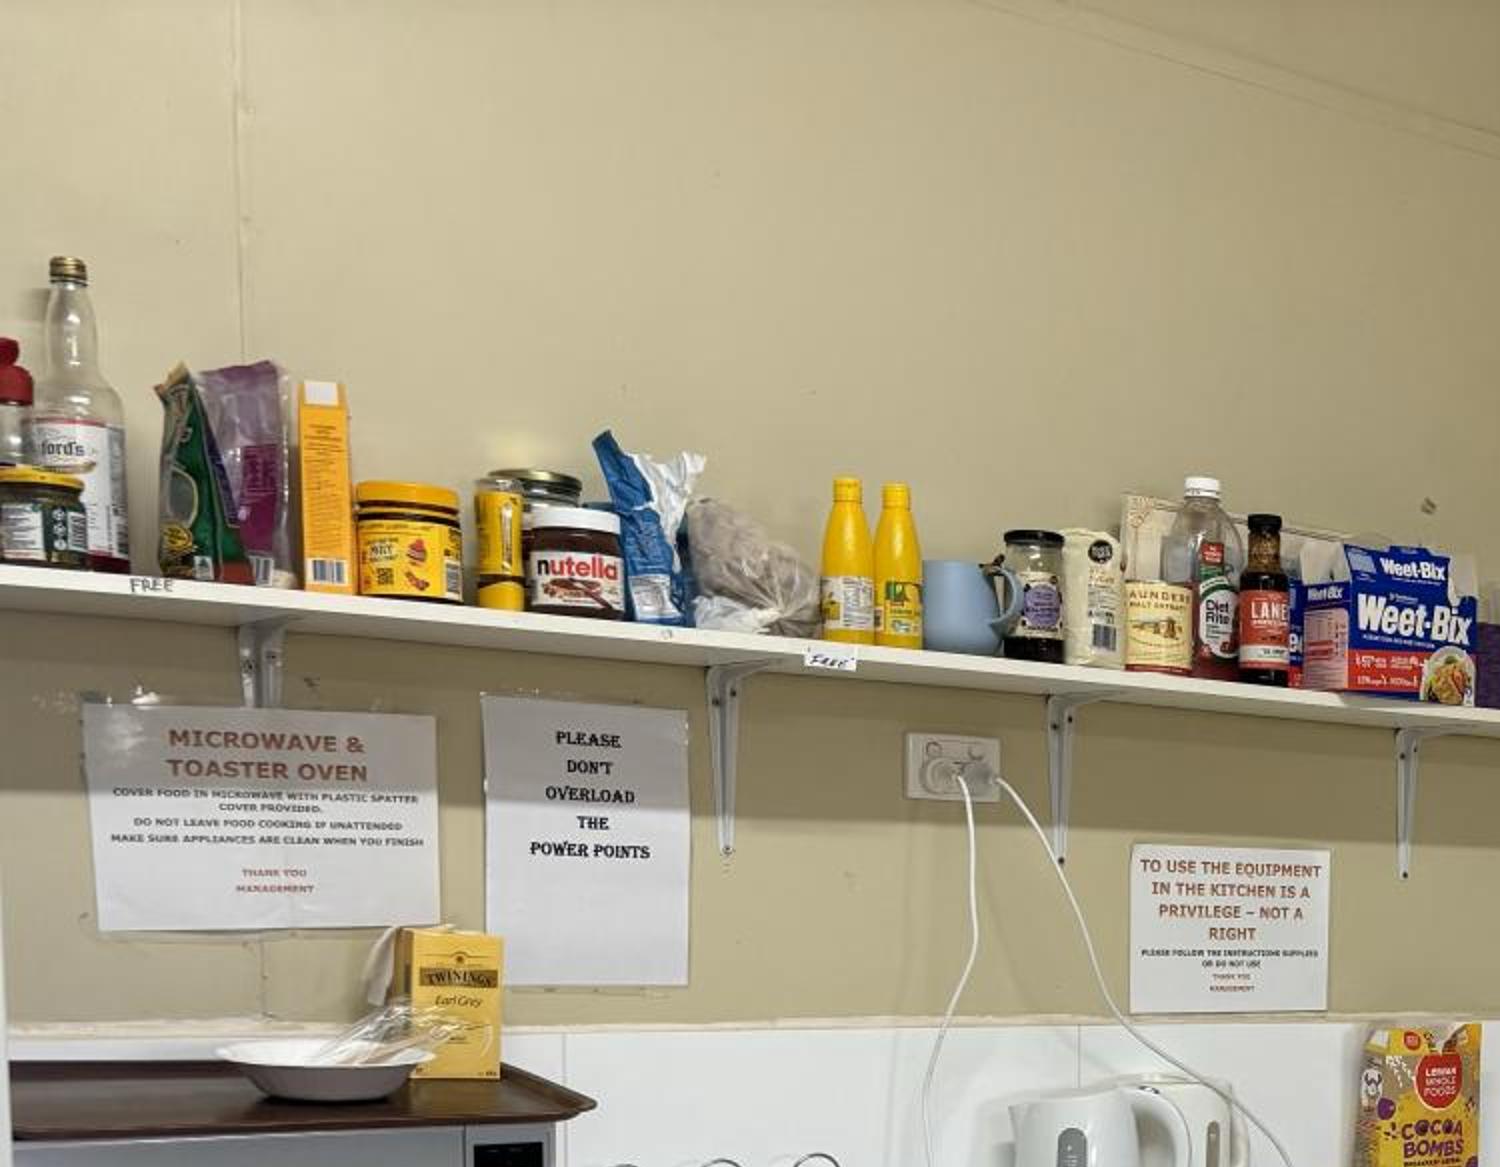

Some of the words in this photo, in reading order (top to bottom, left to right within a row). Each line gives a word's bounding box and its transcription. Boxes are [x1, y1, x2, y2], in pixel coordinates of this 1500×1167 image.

[537, 554, 619, 579] nutella
[1380, 557, 1446, 581] Weet-Bix
[130, 577, 173, 593] FREE
[1206, 599, 1229, 613] Diet
[1206, 612, 1230, 625] Rite
[1357, 593, 1472, 646] Weet-Bix
[169, 729, 337, 753] MICROWAVE
[346, 736, 365, 754] &
[556, 731, 622, 749] PLEASE
[166, 759, 288, 780] TOASTER
[297, 764, 367, 782] OVEN
[566, 759, 614, 775] DON'T
[113, 787, 153, 797] COVER
[157, 788, 191, 798] FOOD
[194, 789, 209, 798] IN
[212, 789, 283, 800] MICROWAVE
[287, 791, 318, 801] WITH
[321, 793, 367, 802] PLASTIC
[545, 786, 636, 804] OVERLOAD
[219, 803, 257, 812] COVER
[260, 804, 322, 813] PROVIDED.
[134, 818, 152, 827] DO
[156, 818, 179, 827] NOT
[183, 818, 220, 828] LEAVE
[224, 819, 254, 828] FOOD
[258, 819, 311, 829] COOKING
[315, 820, 327, 829] IF
[329, 821, 403, 831] UNATTENDED
[576, 815, 610, 831] THE
[111, 834, 144, 843] MAKE
[147, 834, 178, 843] SURE
[183, 835, 256, 844] APPLIANCES
[259, 836, 280, 845] ARE
[283, 836, 320, 845] CLEAN
[323, 837, 357, 846] WHEN
[360, 837, 382, 846] YOU
[385, 838, 424, 847] FINISH
[530, 841, 589, 858] POWER
[593, 844, 651, 860] POINTS
[242, 868, 280, 877] THANK
[283, 868, 307, 877] YOU
[1140, 858, 1162, 873] TO
[1167, 859, 1197, 874] USE
[1201, 861, 1231, 875] THE
[1235, 863, 1322, 878] EQUIPMENT
[236, 885, 314, 893] MANAGEMENT
[1151, 881, 1171, 895] IN
[1176, 882, 1205, 896] THE
[1211, 884, 1275, 898] KITCHEN
[1280, 885, 1295, 898] IS
[1299, 885, 1311, 899] A
[1159, 903, 1241, 919] PRIVILEGE
[1259, 906, 1289, 919] NOT
[1293, 907, 1304, 920] A
[1209, 927, 1257, 941] RIGHT
[435, 995, 456, 1006] Earl
[457, 995, 483, 1009] Grey
[1402, 1118, 1463, 1141] COCOA
[1403, 1137, 1464, 1158] BOMBS
